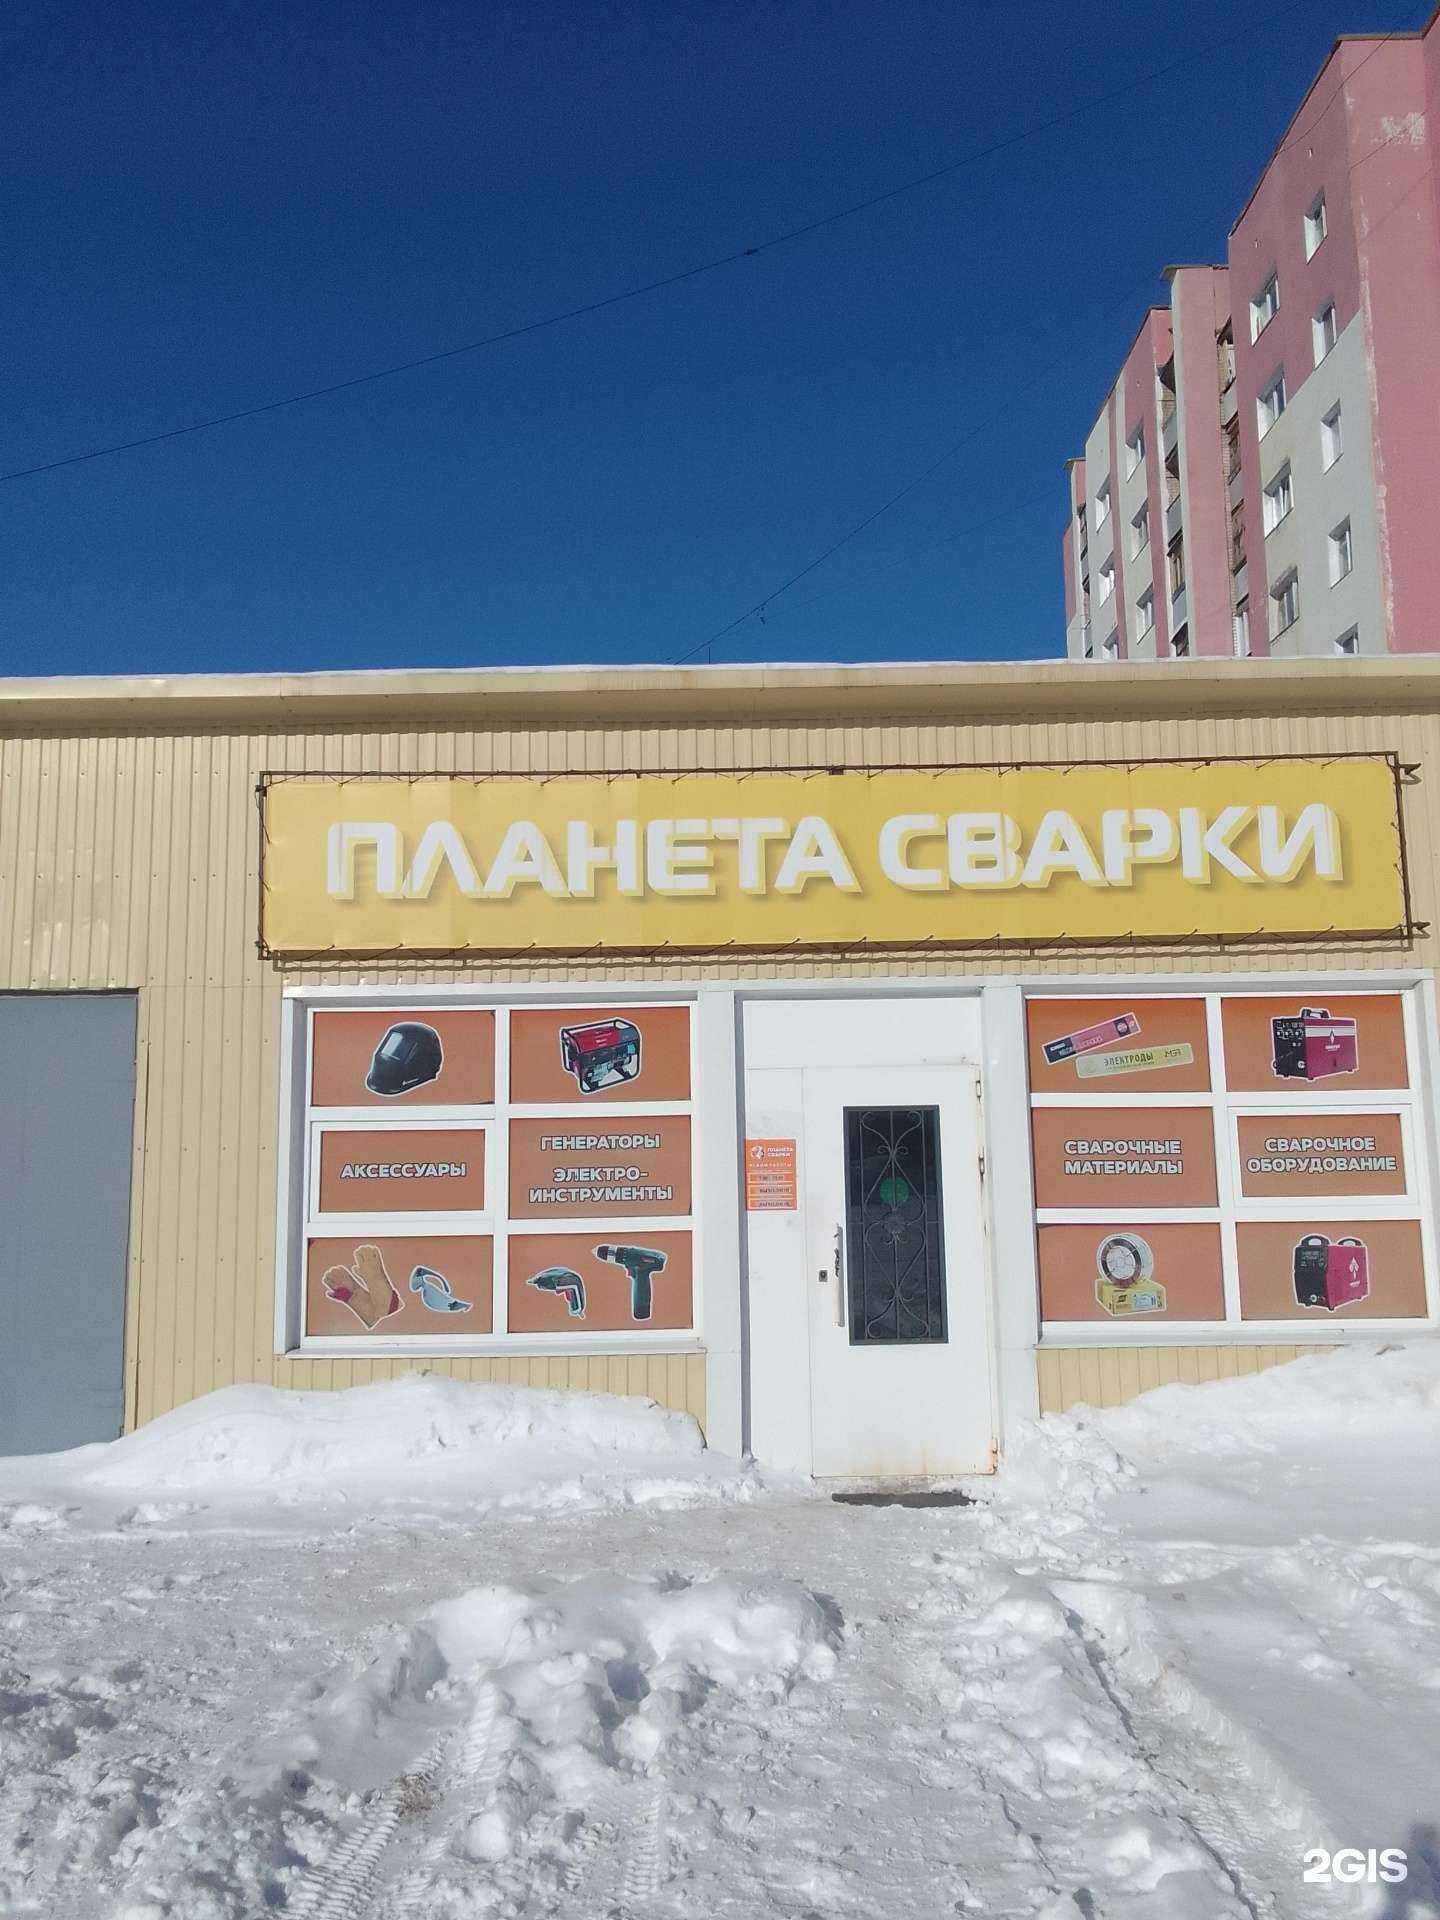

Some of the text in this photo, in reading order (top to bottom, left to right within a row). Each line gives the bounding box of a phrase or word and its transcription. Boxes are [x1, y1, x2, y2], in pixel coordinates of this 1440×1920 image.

[327, 803, 1344, 899] ПЛАНЕТА СВАРКИ
[1103, 1051, 1154, 1067] ЭЛЕКТРОДЫ
[540, 1134, 661, 1151] ГЕНЕРАТОРЫ
[1064, 1139, 1183, 1155] СВАРОЧНЫЕ
[1264, 1137, 1376, 1152] СВАРОЧНОЕ
[340, 1162, 467, 1179] АКСЕССУАРЫ
[1064, 1159, 1184, 1176] МАТЕРИАЛЫ
[1246, 1156, 1397, 1174] ОБОРУДОВАНИЕ
[552, 1166, 649, 1183] ЭЛЕКТРО-
[528, 1185, 673, 1204] ИНСТРУМЕНТЫ
